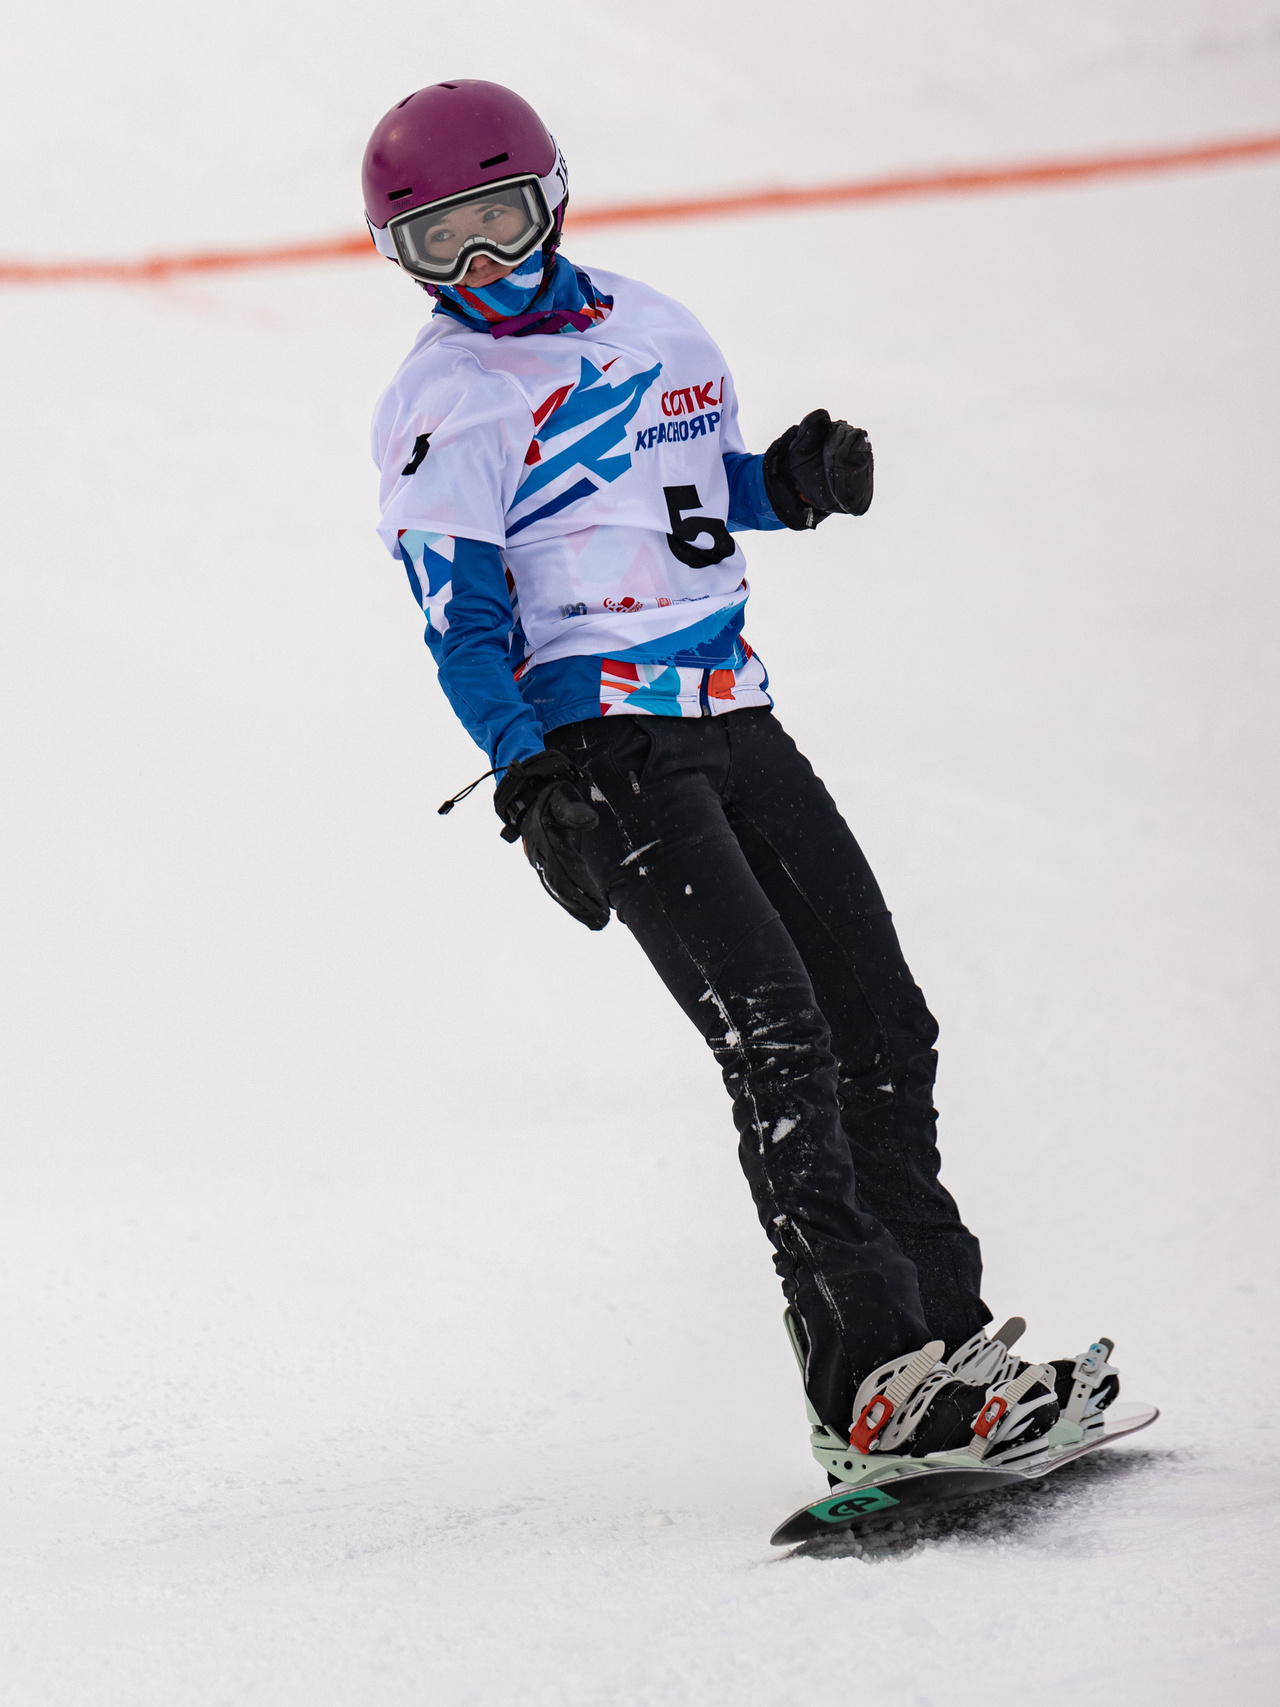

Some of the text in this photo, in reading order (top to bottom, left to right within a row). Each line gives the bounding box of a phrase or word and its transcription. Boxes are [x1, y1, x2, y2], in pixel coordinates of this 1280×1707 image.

[661, 376, 724, 416] СОТК
[635, 409, 724, 451] КРАСНОЯР
[663, 484, 735, 569] 5
